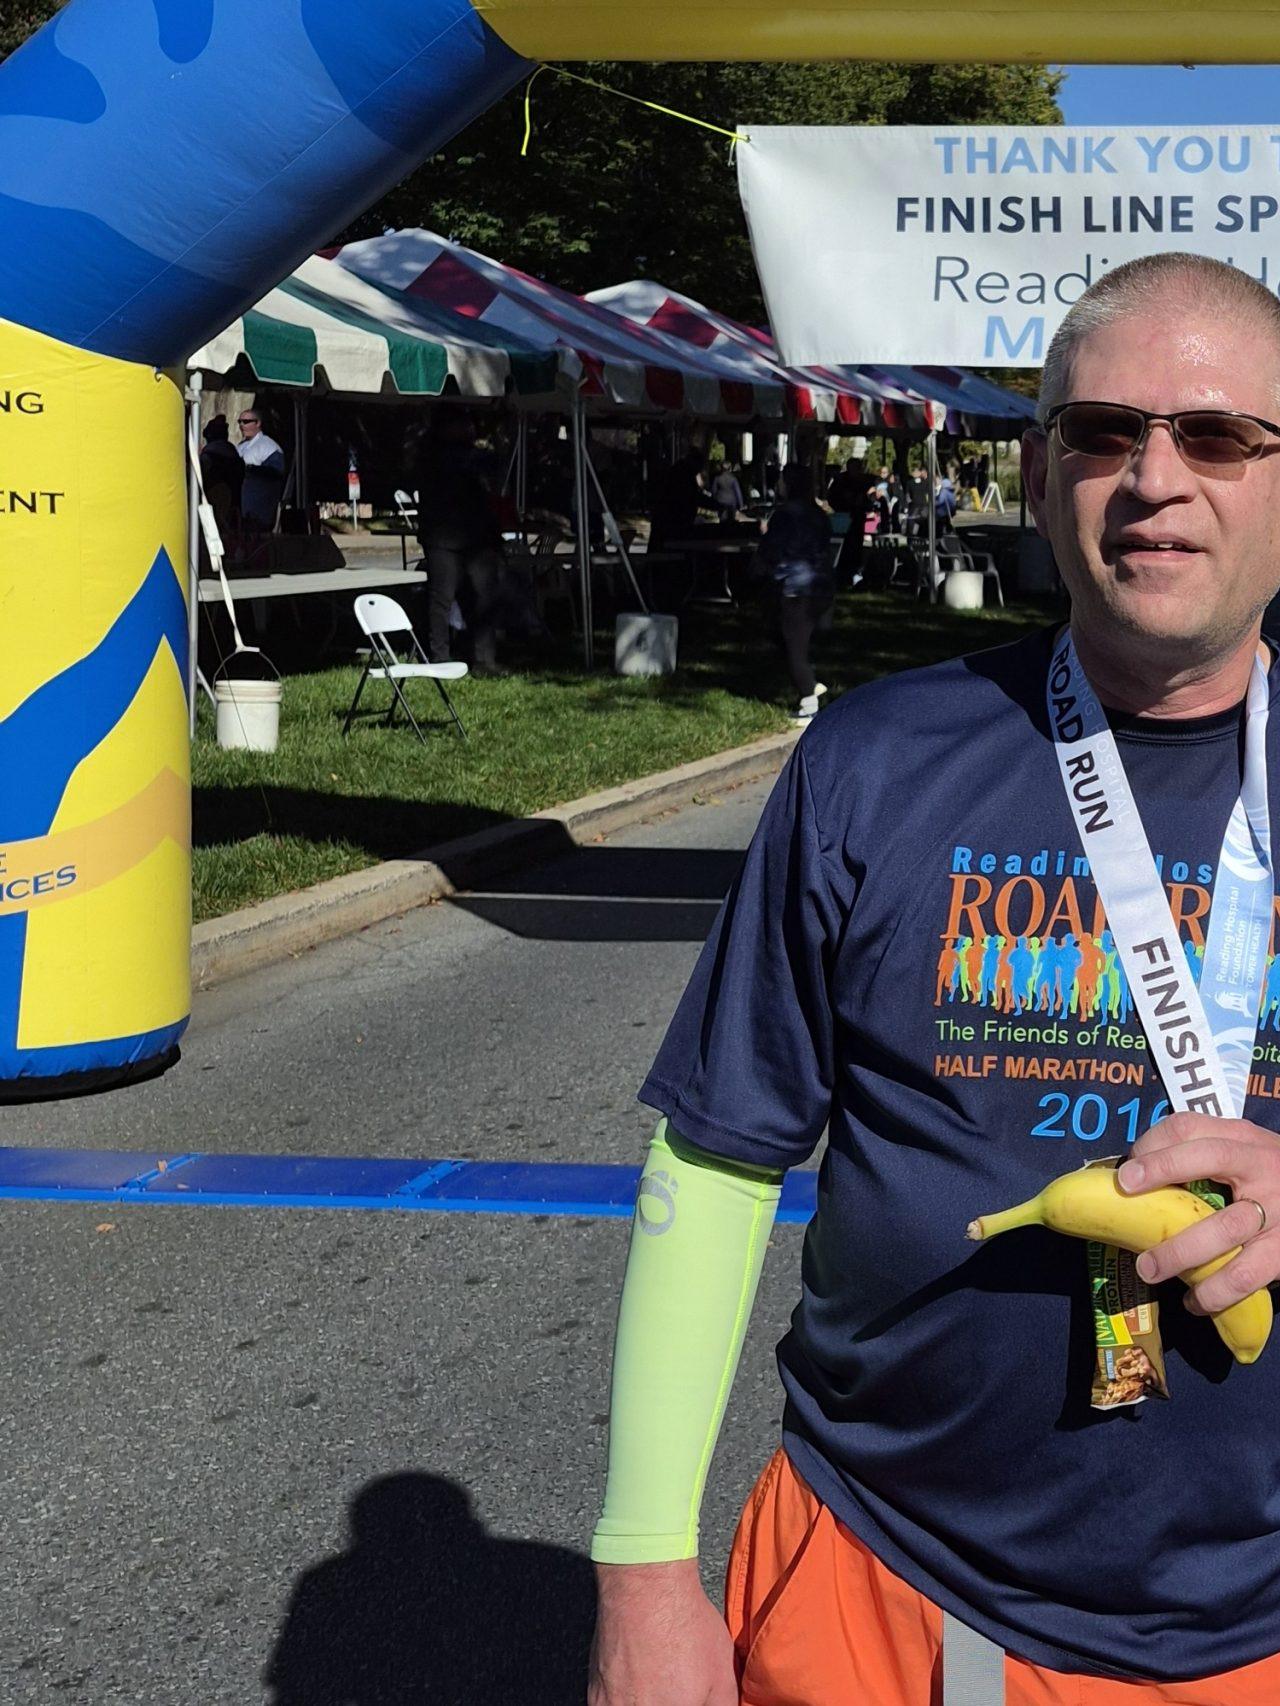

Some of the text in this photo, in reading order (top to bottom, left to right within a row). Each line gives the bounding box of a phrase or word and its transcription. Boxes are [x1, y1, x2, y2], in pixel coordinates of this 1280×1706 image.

[934, 136, 1118, 174] THANK
[1135, 135, 1251, 174] YOU
[896, 195, 1063, 233] FINISH
[1083, 195, 1194, 233] LINE
[933, 253, 1110, 305] Read
[0, 491, 65, 514] NT
[1050, 643, 1114, 834] ROAD RUN
[952, 846, 1091, 877] Readin
[1216, 886, 1240, 983] Reading Hospital
[1228, 920, 1248, 985] Foundation
[1251, 919, 1263, 953] HEALTH
[935, 1019, 975, 1041] The
[984, 1020, 1068, 1045] Friends
[1076, 1025, 1102, 1046] of
[1132, 936, 1223, 1117] FINISHE
[935, 1055, 998, 1078] HALF
[1005, 1056, 1144, 1087] MARATHON
[1105, 1258, 1120, 1314] PROTEIN
